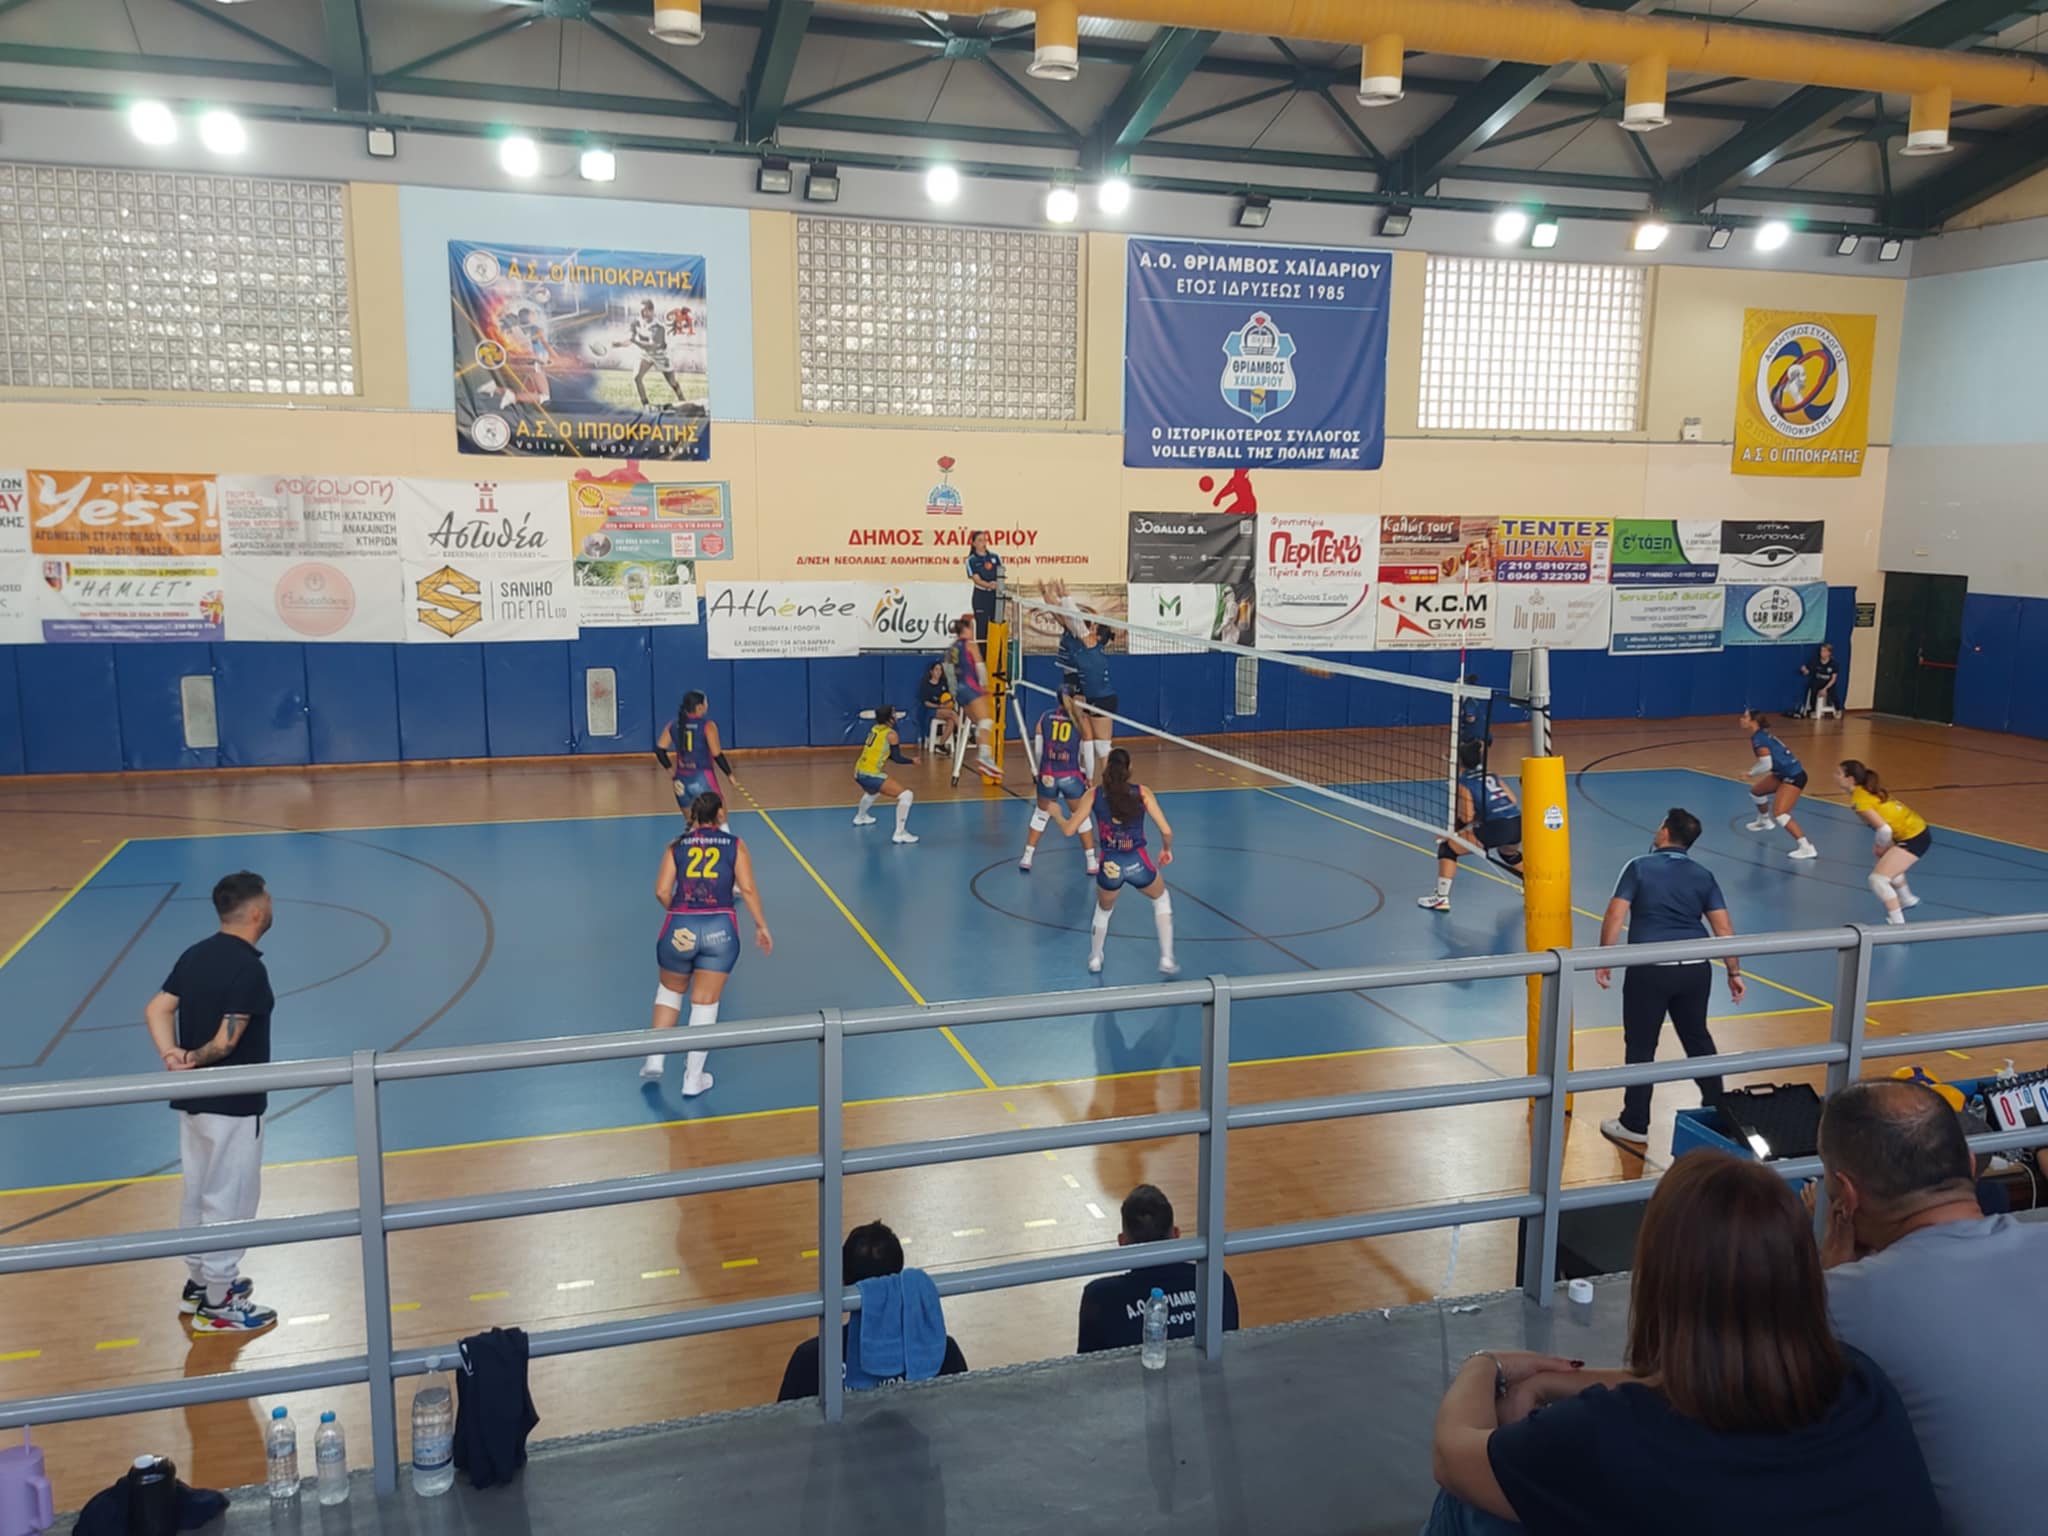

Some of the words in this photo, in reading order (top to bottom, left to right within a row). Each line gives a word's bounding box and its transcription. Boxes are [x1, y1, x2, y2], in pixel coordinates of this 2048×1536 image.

[1140, 252, 1177, 270] Α.Ο.
[1183, 254, 1280, 275] ΘΡΙΑΜΒΟΣ
[1285, 257, 1382, 279] ΧΑΪΔΑΡΙΟΥ
[549, 263, 565, 282] Ο
[568, 264, 693, 290] ΙΠΠΟΚΡΑΤΗΣ
[1176, 278, 1217, 295] ΕΤΟΣ
[1222, 280, 1302, 298] ΙΔΡΥΣΕΩΣ
[1308, 284, 1345, 301] 1985
[1810, 326, 1845, 363] ΣΥΛΛΟΓΟΣ
[1232, 360, 1286, 374] ΘΡΙΑΜΒΟΣ
[515, 421, 553, 439] Α.Σ.
[559, 422, 573, 440] Ο
[578, 422, 699, 443] ΙΠΠΟΚΡΑΤΗΣ
[1777, 414, 1834, 436] ΙΠΠΟΚΡΑΤΗΣ
[1151, 427, 1162, 440] Ο
[1167, 428, 1283, 442] ΙΣΤΟΡΙΚΟΤΕΡΟΣ
[1286, 429, 1361, 443] ΣΥΛΛΟΓΟΣ
[516, 440, 567, 452] Volley
[590, 442, 636, 455] Rugby
[1152, 445, 1242, 459] VOLLEYBALL
[1246, 446, 1274, 459] ΤΗΣ
[1278, 447, 1326, 460] ΠΟΛΗΣ
[1328, 447, 1361, 460] ΜΑΣ
[1769, 448, 1779, 462] Ο
[1782, 448, 1861, 464] ΙΠΠΟΚΡΑΤΗΣ
[0, 479, 22, 489] ΩΝ
[101, 482, 189, 496] PIZZA
[35, 474, 219, 529] Yess!
[428, 511, 550, 549] Αστυθέα
[1501, 520, 1610, 537] ΤΕΝΤΕΣ
[356, 537, 397, 546] ΚΤΗΡΙΩΝ
[849, 529, 924, 546] ΔΗΜΟΣ
[797, 556, 830, 565] Δ/ΝΣΗ
[835, 556, 887, 565] ΝΕΟΛΑΙΑΣ
[891, 556, 950, 565] ΑΘΛΗΤΙΚΩΝ
[1036, 556, 1089, 565] ΥΠΗΡΕΣΙΩΝ
[1508, 561, 1531, 570] 210
[1507, 572, 1538, 580] 6946
[1541, 572, 1586, 580] 322930
[1415, 594, 1488, 612] K.C.M
[1428, 617, 1487, 630] GYMS
[1772, 611, 1794, 622] WASH
[1052, 720, 1072, 742] 10
[686, 846, 720, 878] 22
